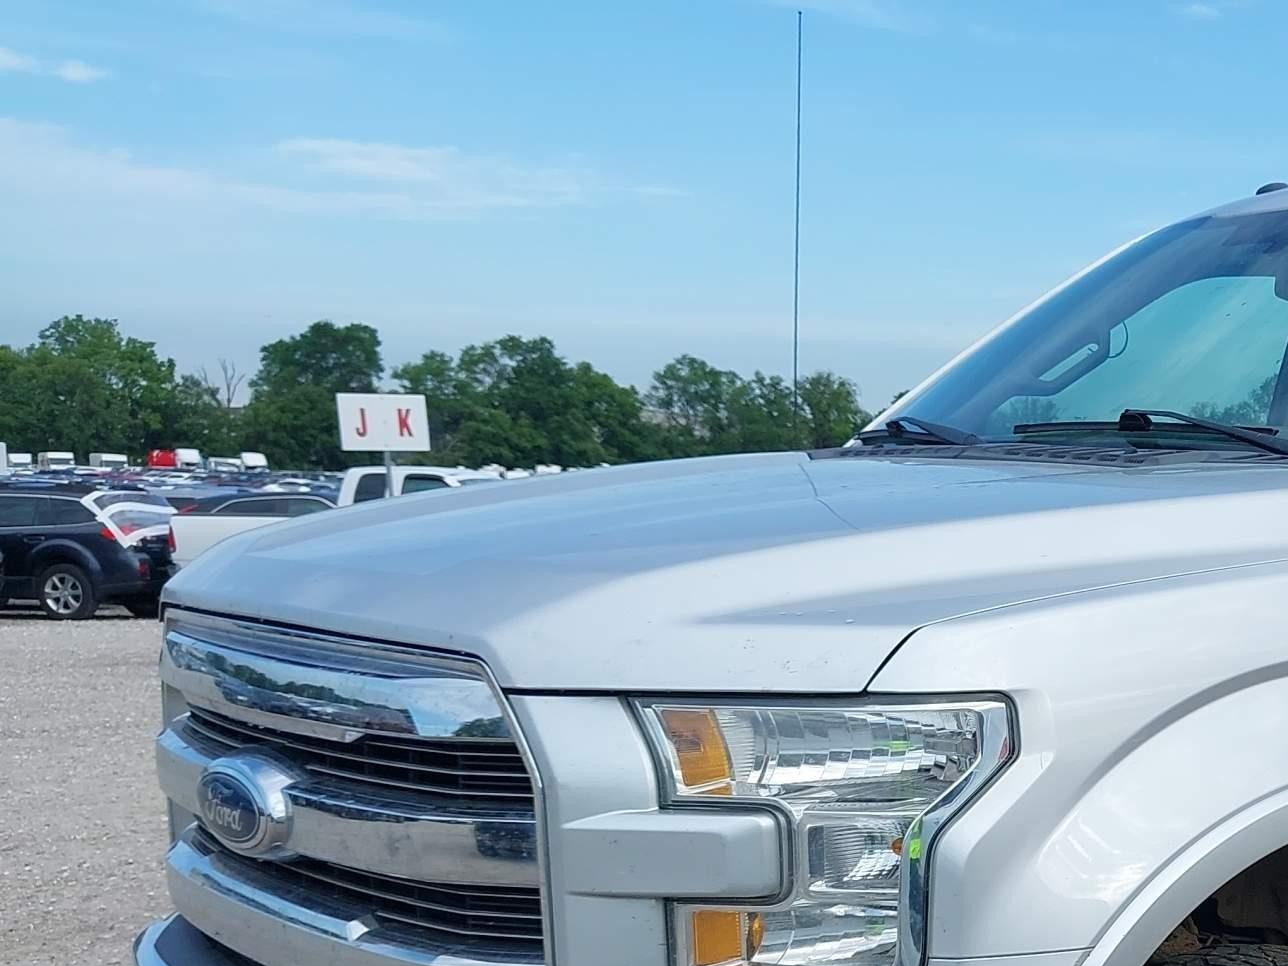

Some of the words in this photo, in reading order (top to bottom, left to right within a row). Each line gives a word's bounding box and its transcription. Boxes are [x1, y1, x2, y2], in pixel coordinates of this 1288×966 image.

[355, 407, 368, 438] J
[396, 408, 415, 438] K
[207, 781, 243, 832] Ford
